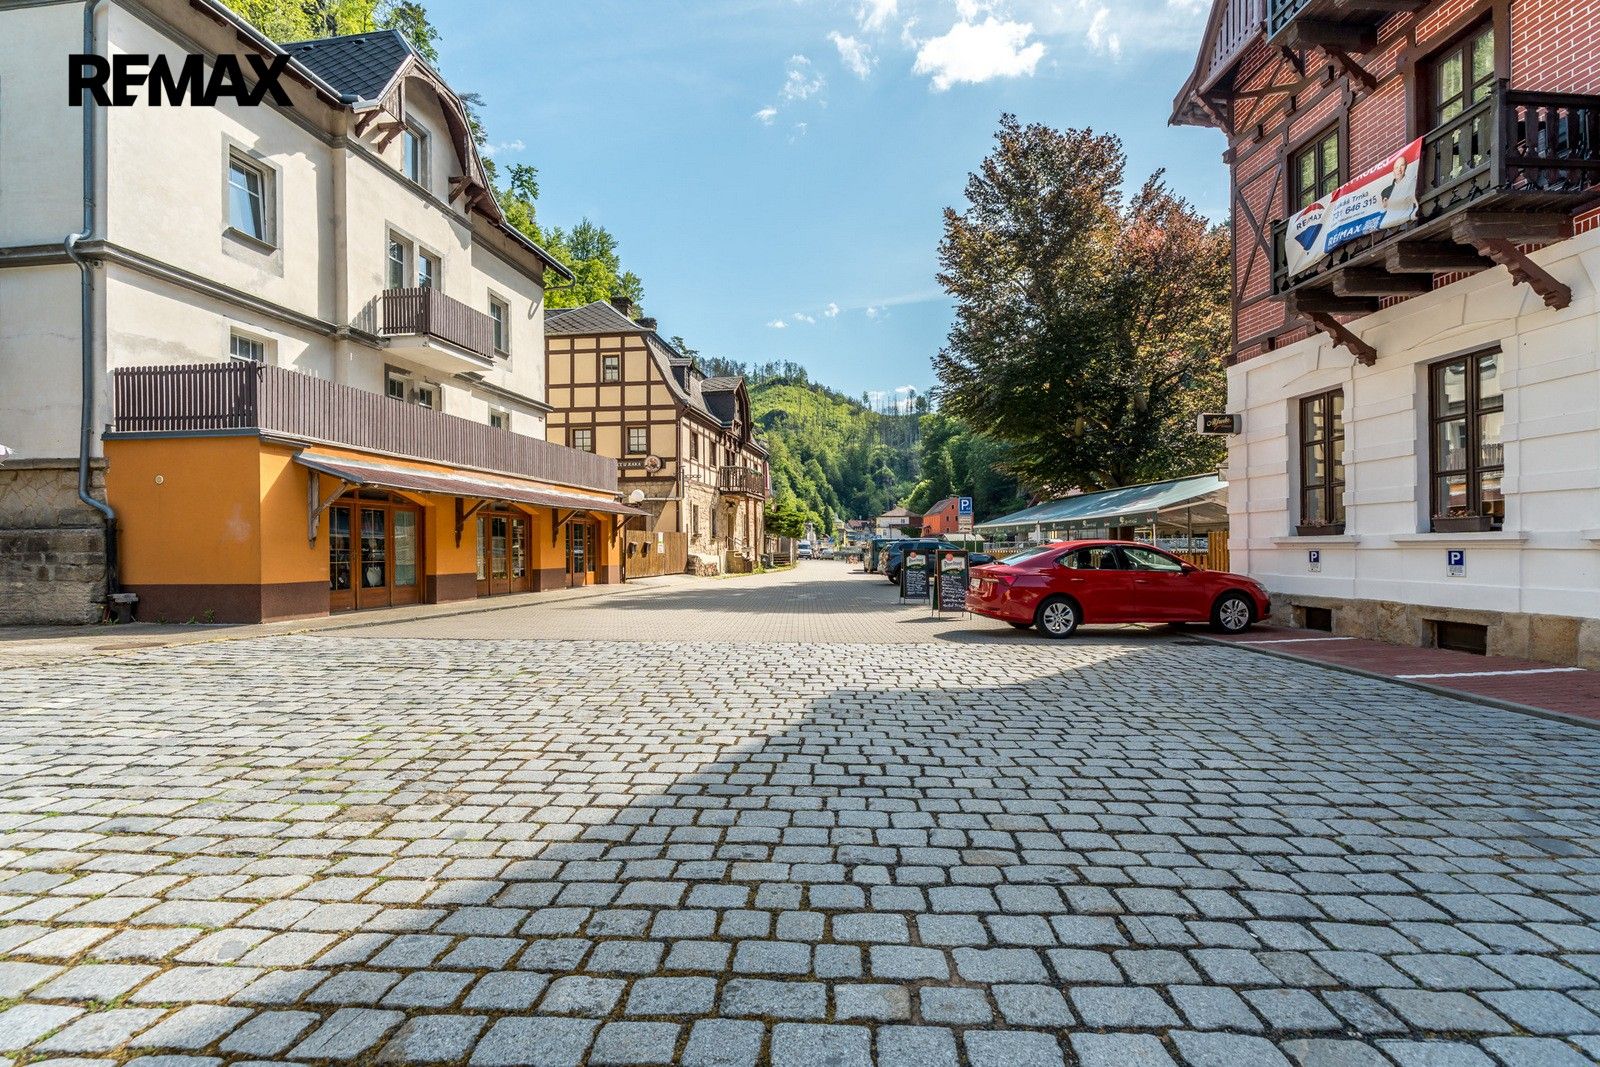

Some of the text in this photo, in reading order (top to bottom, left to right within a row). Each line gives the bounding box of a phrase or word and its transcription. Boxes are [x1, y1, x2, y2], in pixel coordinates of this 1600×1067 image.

[1344, 202, 1361, 215] 646
[1362, 195, 1378, 208] 315
[961, 499, 970, 511] P
[1311, 551, 1318, 562] P
[1451, 552, 1461, 565] P
